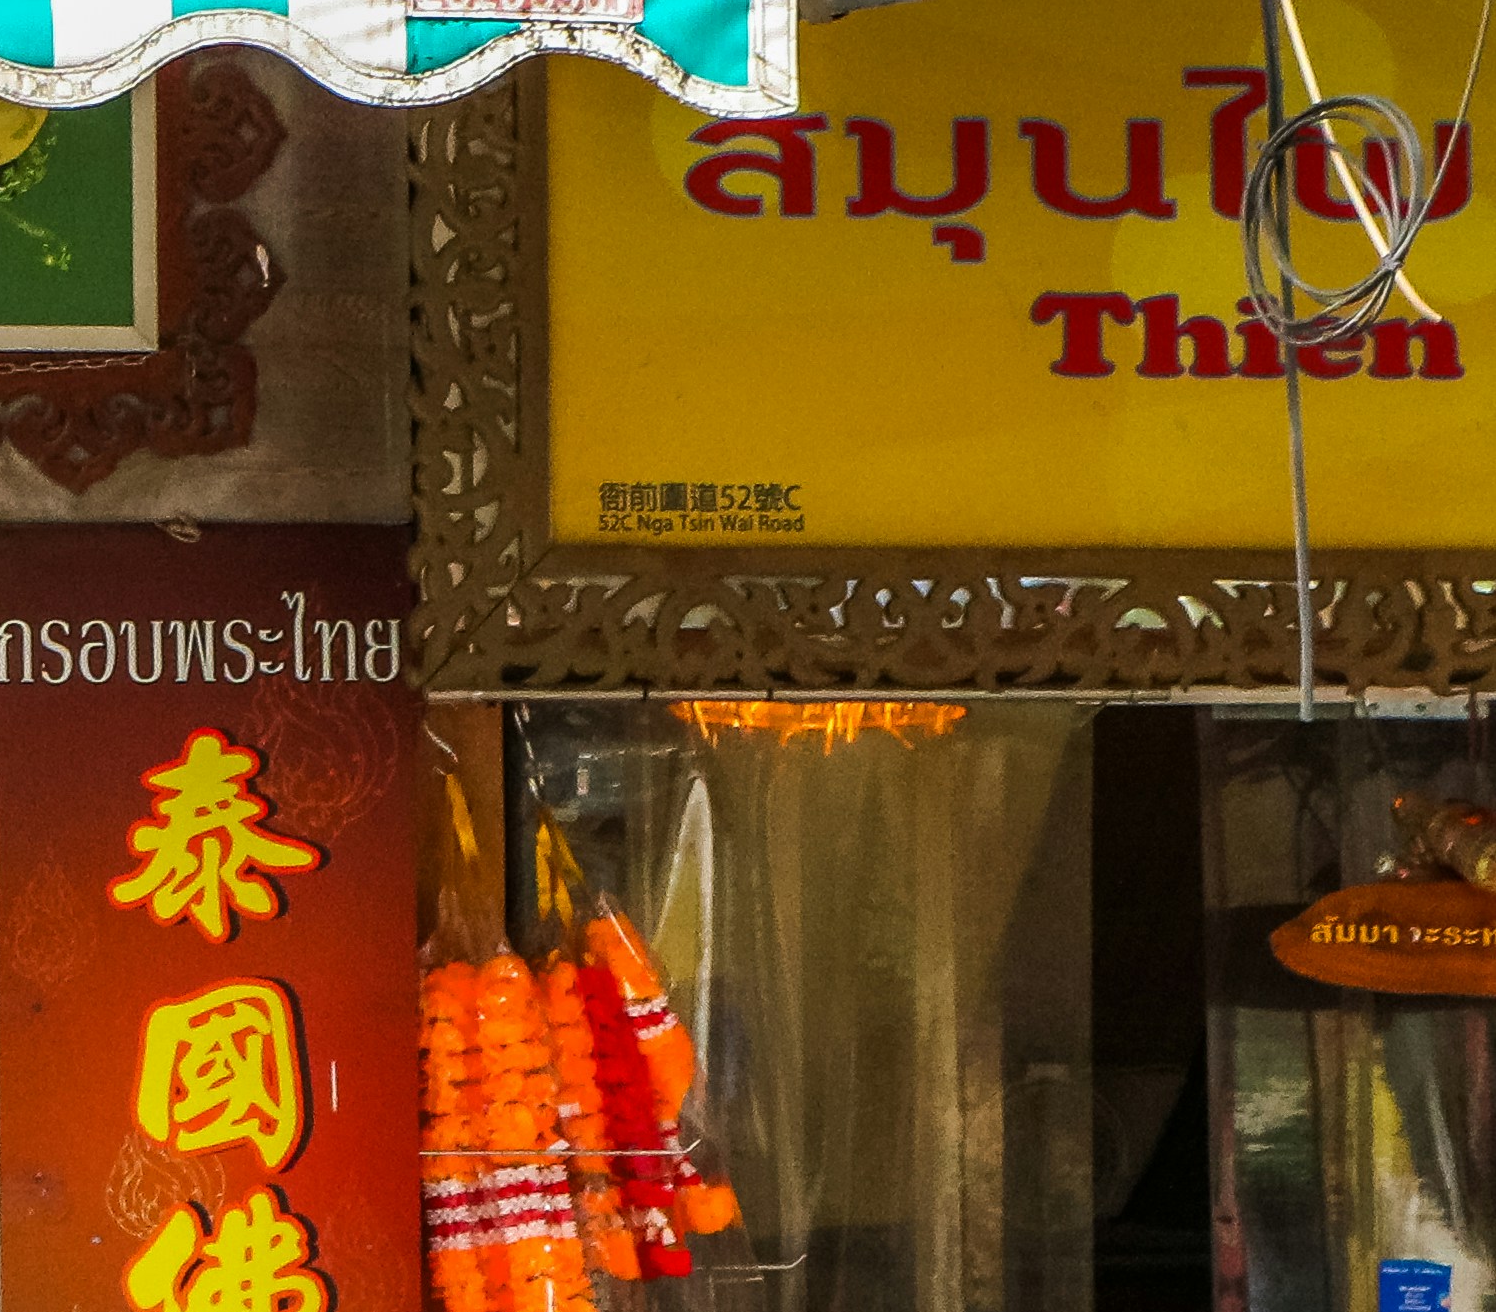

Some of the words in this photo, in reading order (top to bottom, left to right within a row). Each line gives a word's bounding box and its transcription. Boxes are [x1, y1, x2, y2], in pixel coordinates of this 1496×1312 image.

[637, 515, 674, 535] Nga
[679, 514, 715, 532] Tsin
[720, 515, 753, 532] Wai
[758, 514, 806, 532] Road
